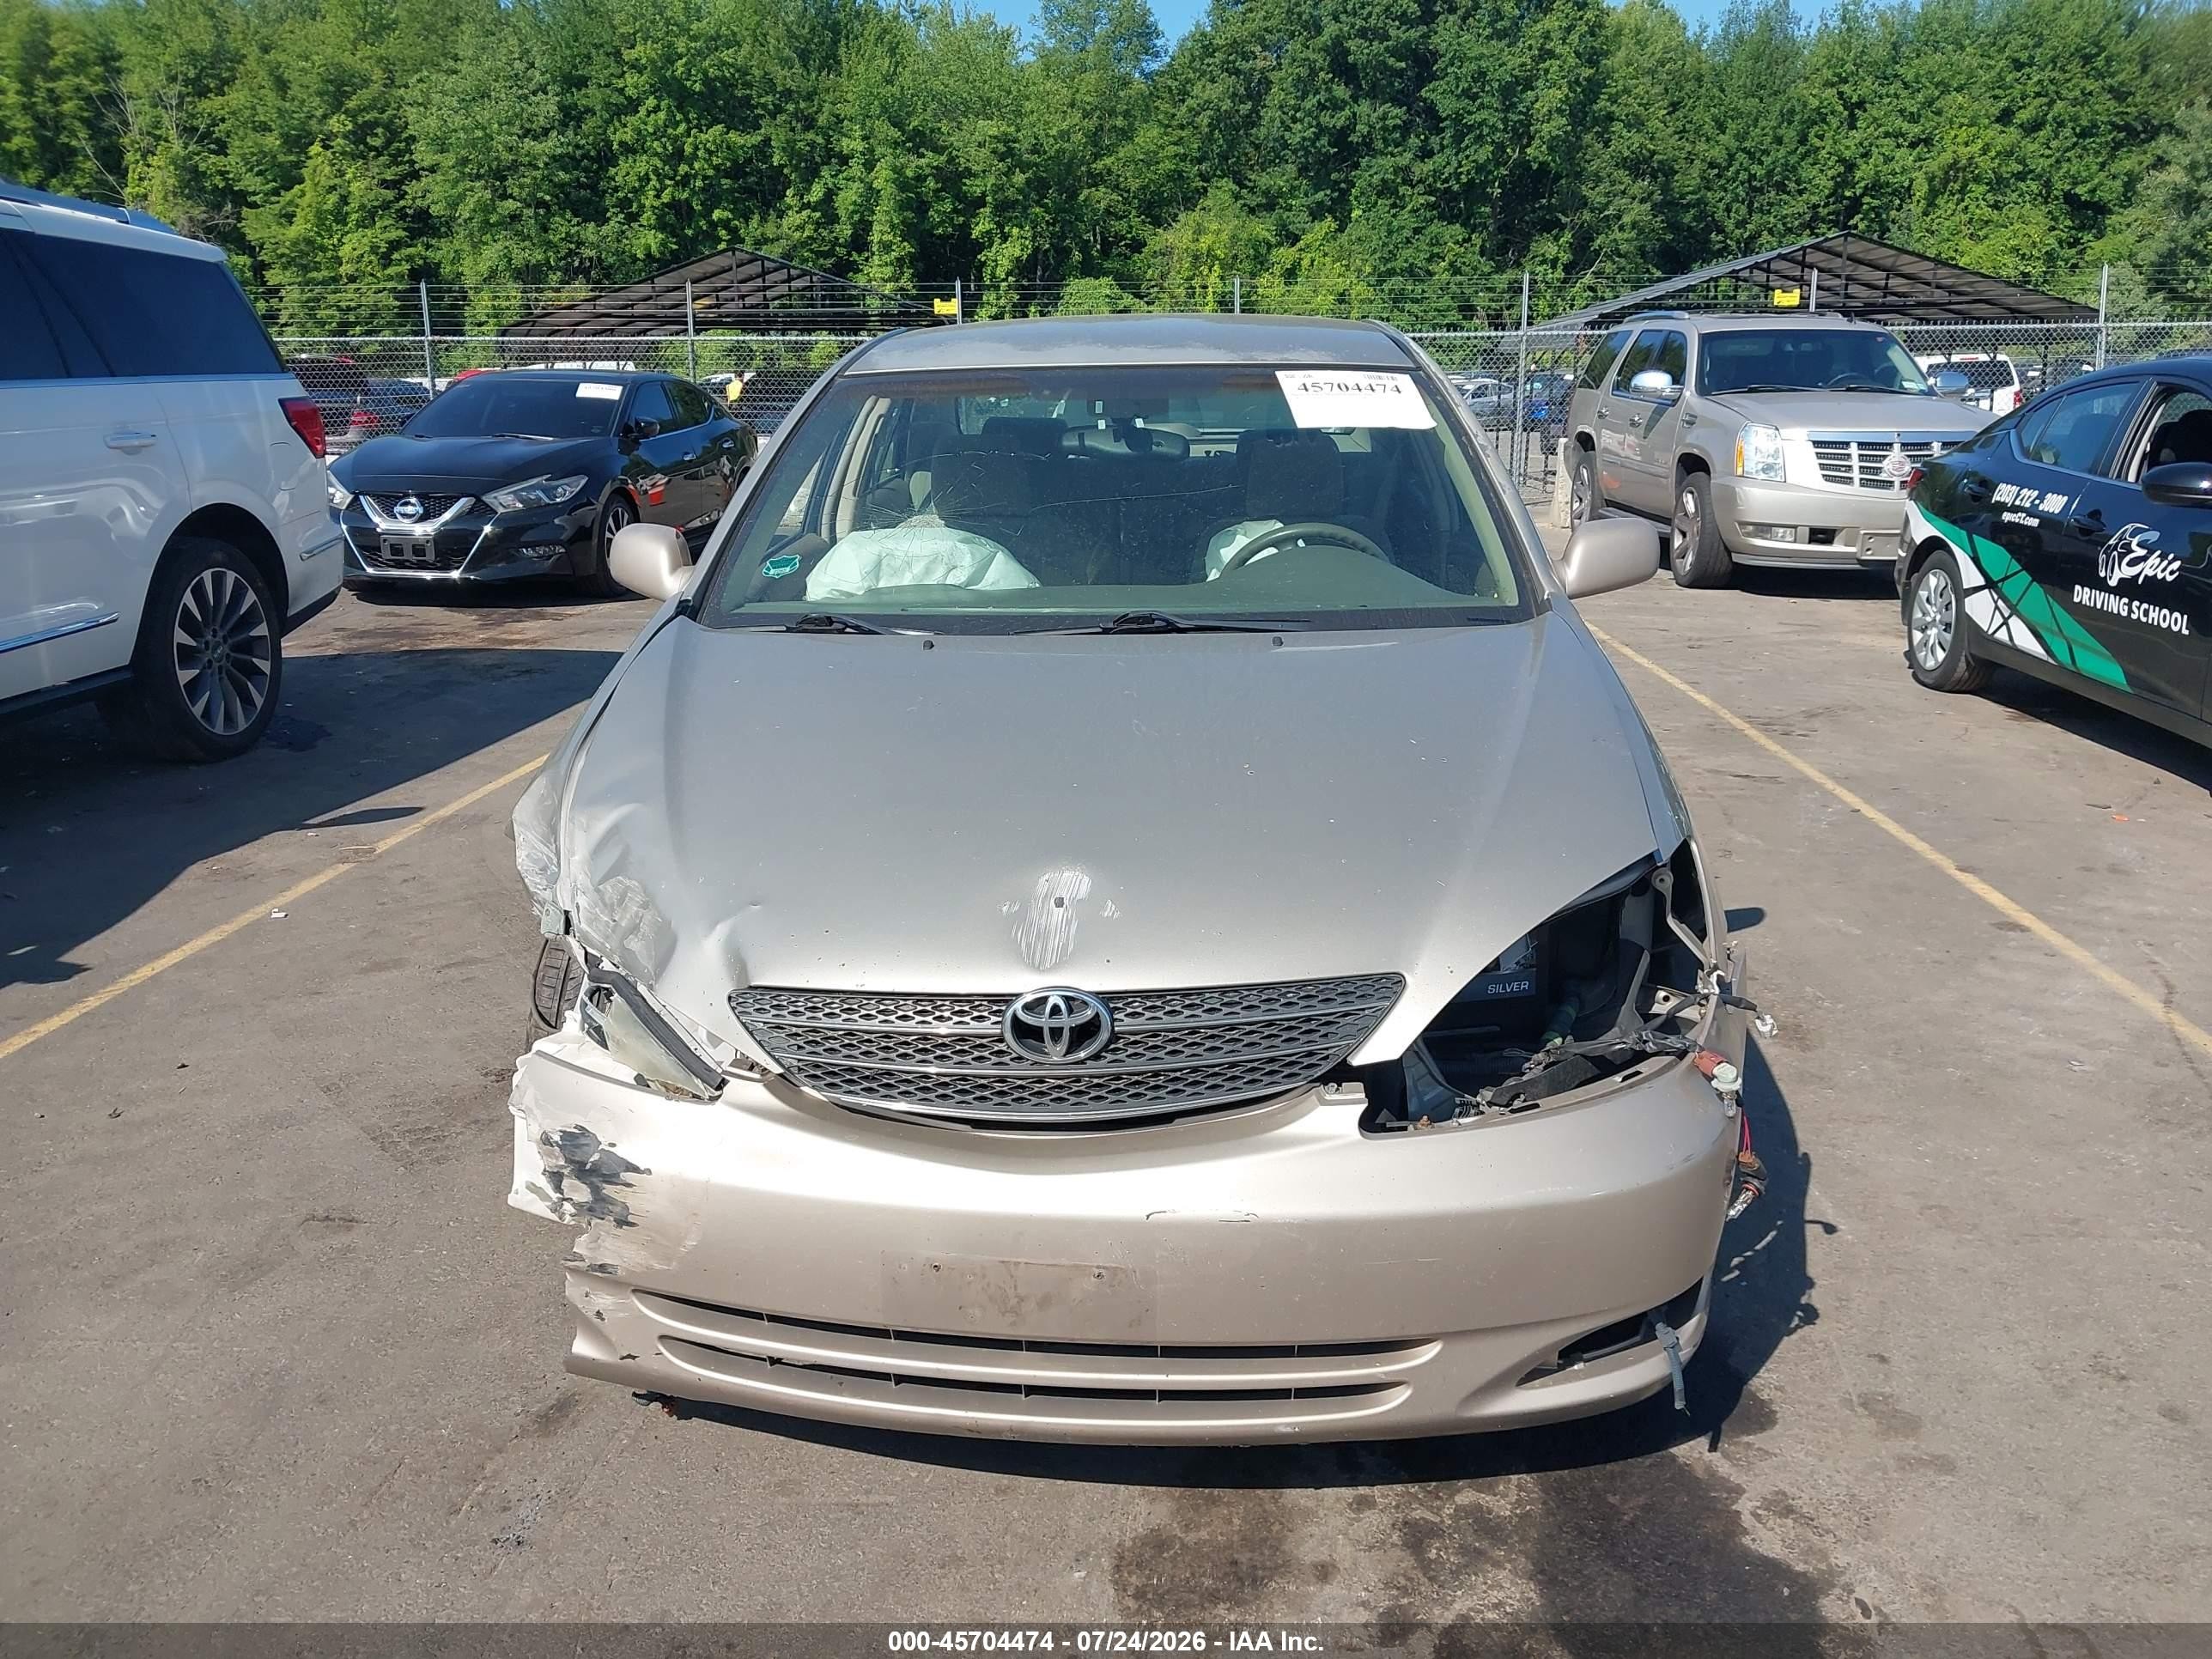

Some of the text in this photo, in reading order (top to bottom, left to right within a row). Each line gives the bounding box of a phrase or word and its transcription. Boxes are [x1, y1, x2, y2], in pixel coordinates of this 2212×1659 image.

[1297, 382, 1402, 394] 45704474
[1991, 482, 2020, 507] (203)
[2014, 487, 2039, 508] 212
[2039, 492, 2068, 514] 3000
[2120, 531, 2182, 585] Epic
[2073, 584, 2190, 635] DRIVING SCHOOL
[1487, 981, 1529, 994] SILVER
